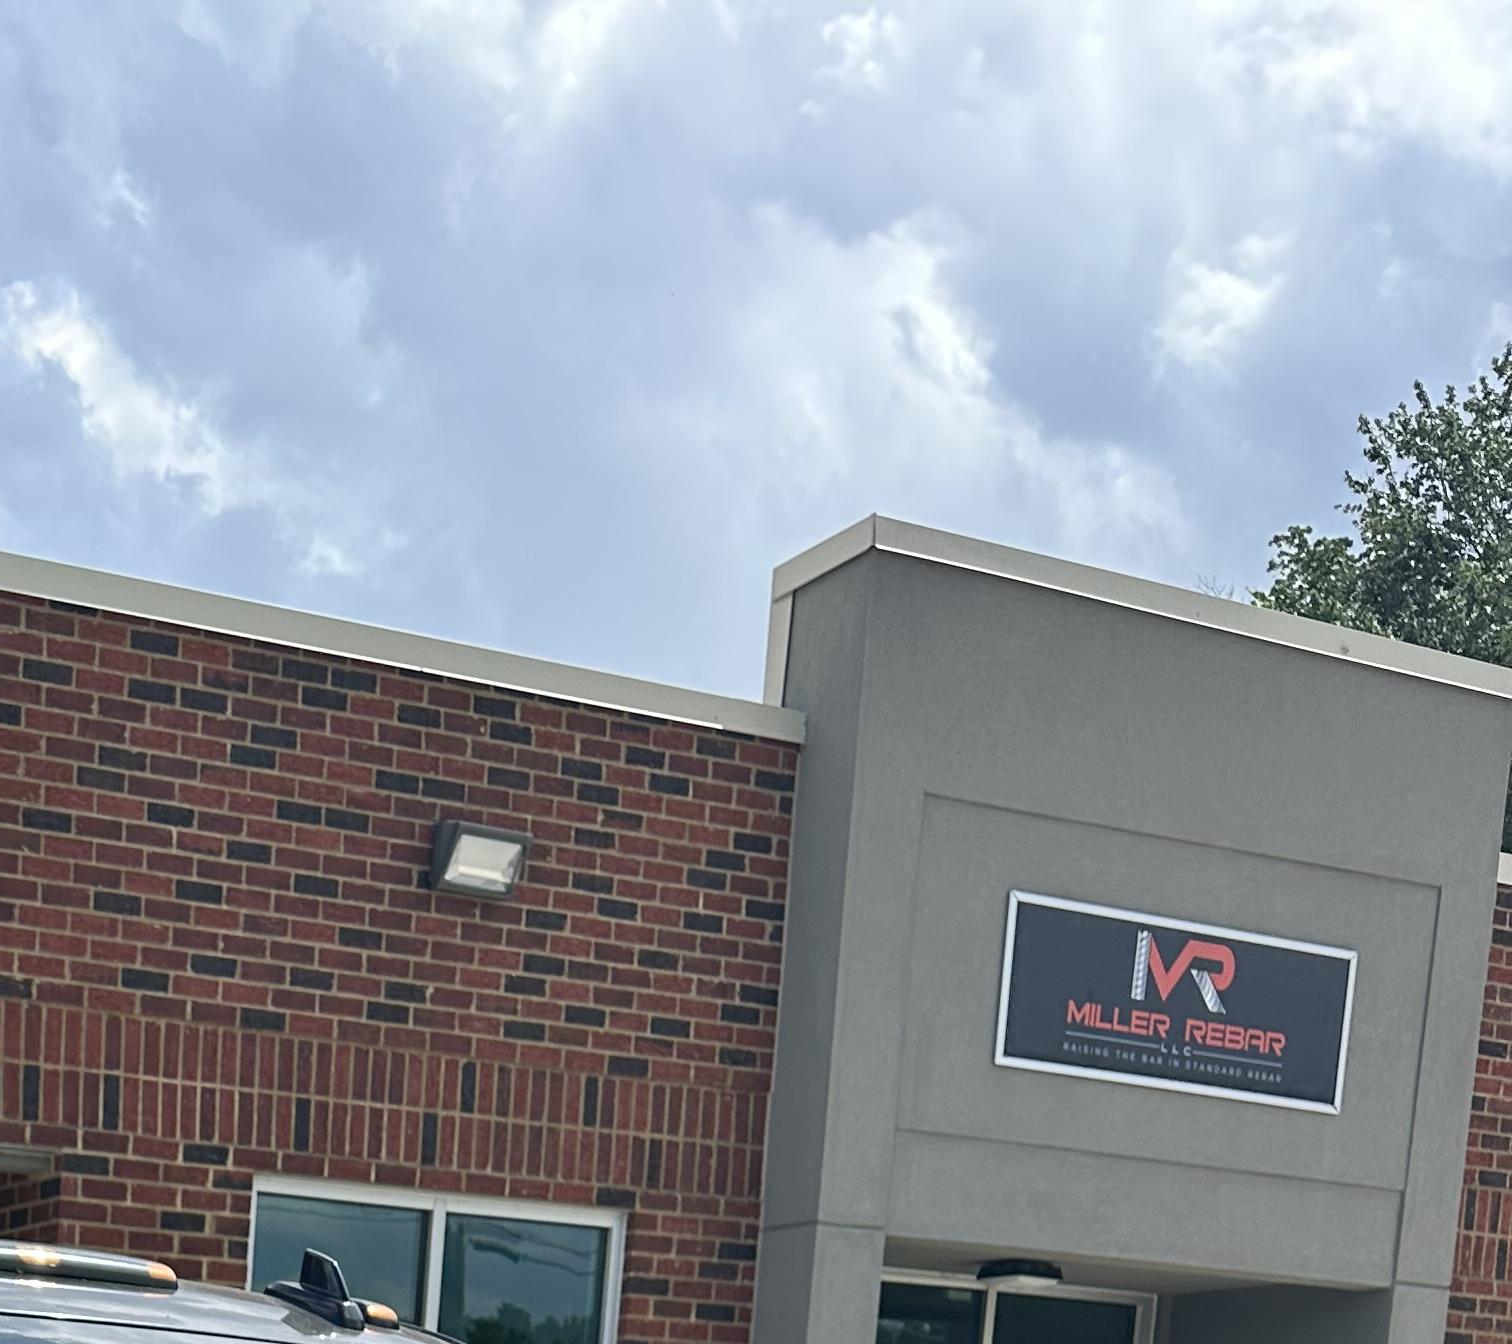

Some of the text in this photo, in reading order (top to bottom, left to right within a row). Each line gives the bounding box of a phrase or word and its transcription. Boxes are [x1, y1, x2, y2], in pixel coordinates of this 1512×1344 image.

[1066, 999, 1286, 1057] MILLER REBAR
[1062, 1041, 1109, 1058] RAISING
[1115, 1049, 1136, 1063] THE
[1141, 1053, 1163, 1066] BAR
[1168, 1057, 1180, 1068] IN
[1185, 1059, 1242, 1078] STANDARD
[1160, 1042, 1193, 1058] LLC
